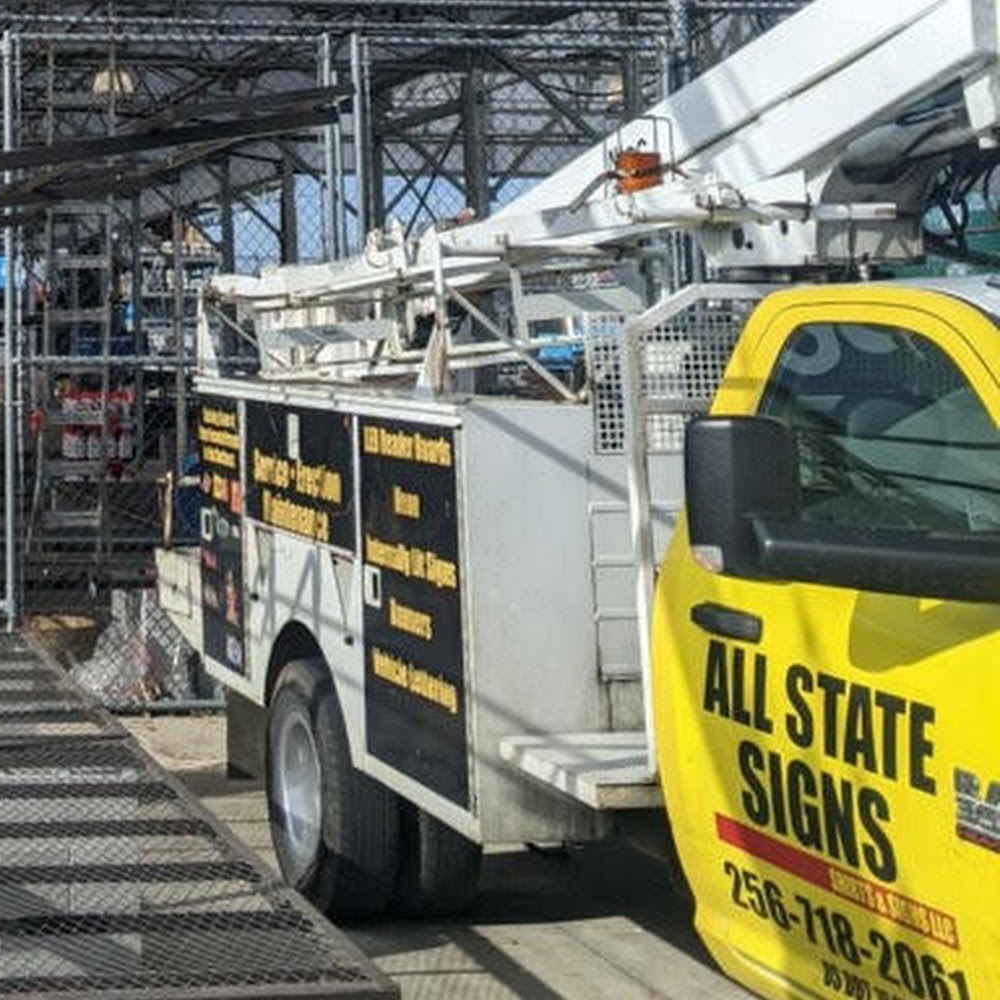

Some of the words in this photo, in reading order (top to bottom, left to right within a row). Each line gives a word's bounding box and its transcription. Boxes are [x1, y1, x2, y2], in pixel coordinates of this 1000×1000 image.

[703, 639, 773, 734] ALL
[785, 663, 936, 796] STATE
[738, 740, 897, 883] SIGNS
[724, 861, 969, 1000] 256-718-2061
